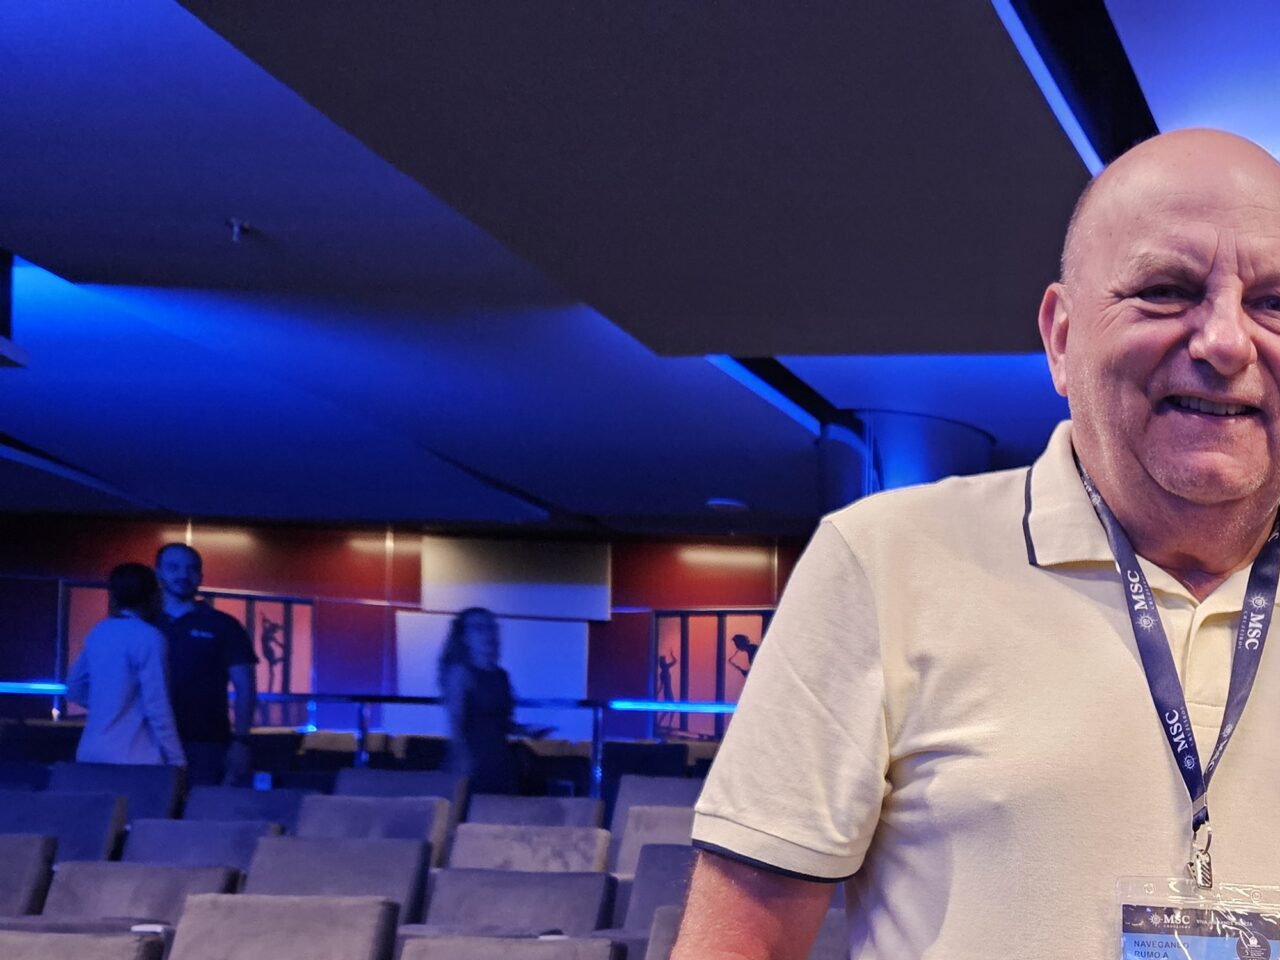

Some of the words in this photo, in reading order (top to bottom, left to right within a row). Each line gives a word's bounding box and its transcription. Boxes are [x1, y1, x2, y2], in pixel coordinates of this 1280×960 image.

[1127, 569, 1148, 611] MSC
[1245, 611, 1265, 651] MSC
[1165, 709, 1189, 753] MSC
[1163, 914, 1190, 925] MSC
[1134, 950, 1161, 959] RUMO
